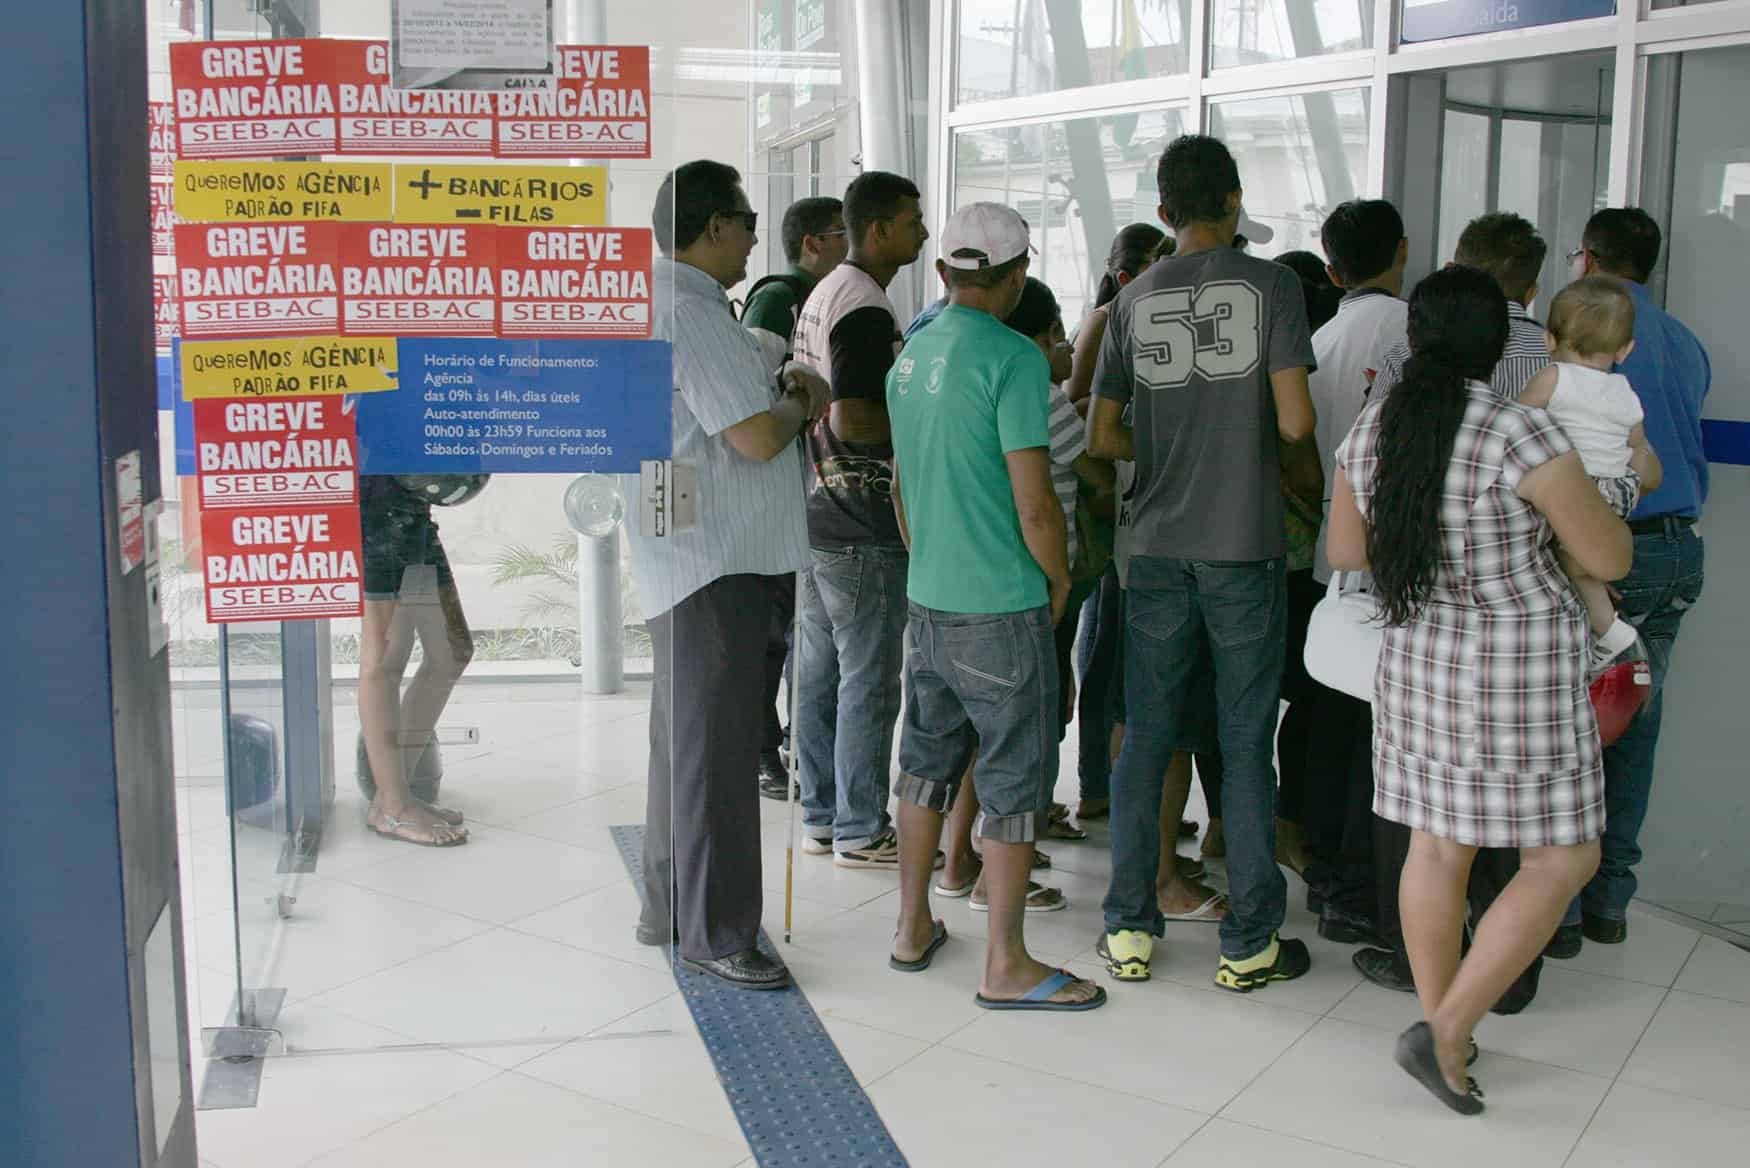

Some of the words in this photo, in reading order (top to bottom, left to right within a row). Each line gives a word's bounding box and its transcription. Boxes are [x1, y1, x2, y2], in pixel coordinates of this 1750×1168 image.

[202, 45, 304, 78] GREVE
[554, 50, 619, 79] EVE
[177, 78, 334, 118] BANCÁRIA
[498, 81, 648, 117] BANCÁRIA
[193, 120, 321, 141] SEEB-AC
[352, 119, 479, 138] SEEB-AC
[511, 123, 633, 140] SEEB-AC
[297, 169, 381, 195] AGÊNCIA
[449, 178, 593, 200] BANCÁRIOS
[226, 195, 293, 218] PADRÃO
[303, 201, 341, 216] FIFA
[489, 205, 554, 222] FILAS
[207, 225, 306, 257] GREVE
[369, 227, 467, 257] GREVE
[527, 231, 622, 261] GREVE
[181, 257, 337, 297] BANCÁRIA
[343, 259, 495, 295] BANCÁRIA
[501, 262, 649, 298] BANCÁRIA
[196, 299, 323, 320] SEEB-AC
[357, 302, 480, 318] SEEB-AC
[513, 304, 635, 321] SEEB-AC
[1133, 280, 1262, 390] 53
[303, 343, 385, 368] AGÊNCIA
[424, 353, 475, 366] Horário
[479, 354, 495, 366] de
[499, 354, 599, 368] Funcionamento:
[233, 373, 300, 395] PADRÃO
[310, 374, 348, 391] FIFA
[424, 372, 473, 387] Agência
[424, 390, 445, 401] das
[448, 390, 473, 402] 09h
[522, 390, 547, 402] dias
[225, 401, 324, 432] GREVE
[424, 407, 540, 420] Auto-atendimento
[424, 425, 464, 437] 00h00
[484, 425, 522, 438] 23h59
[527, 425, 582, 438] Funciona
[585, 428, 607, 438] aos
[200, 432, 353, 471] BANCÁRIA
[481, 442, 545, 458] Domingos
[548, 446, 557, 456] e
[560, 442, 613, 456] Feriados
[215, 473, 341, 493] SEEB-AC
[232, 514, 330, 545] GREVE
[207, 545, 359, 584] BANCÁRIA
[222, 585, 346, 605] SEEB-AC
